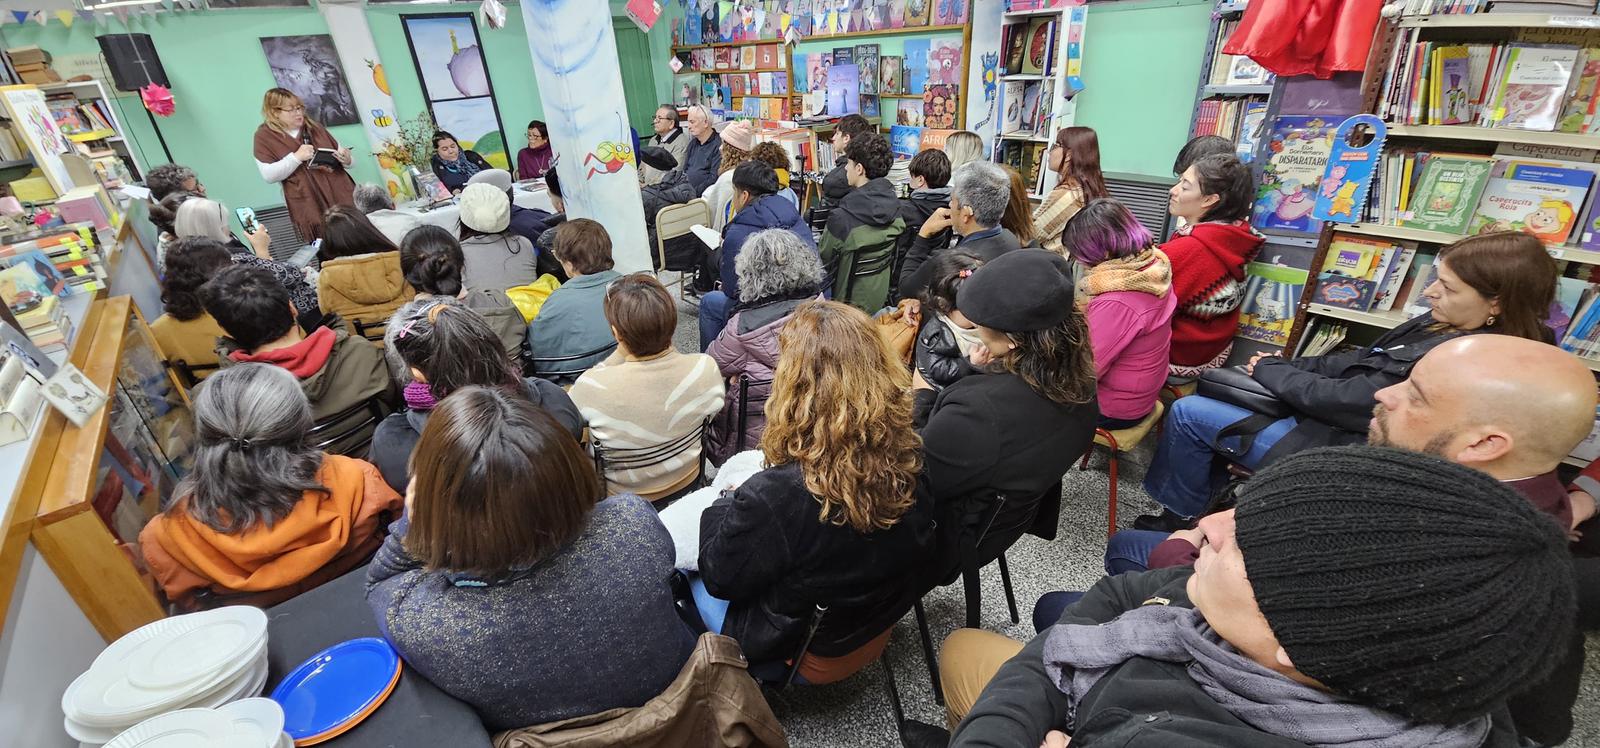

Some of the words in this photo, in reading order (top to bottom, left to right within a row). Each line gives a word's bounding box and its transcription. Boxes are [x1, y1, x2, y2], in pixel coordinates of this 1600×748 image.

[1512, 142, 1583, 157] Caperucita
[1489, 195, 1533, 206] Caperucita
[1499, 202, 1517, 210] Roja
